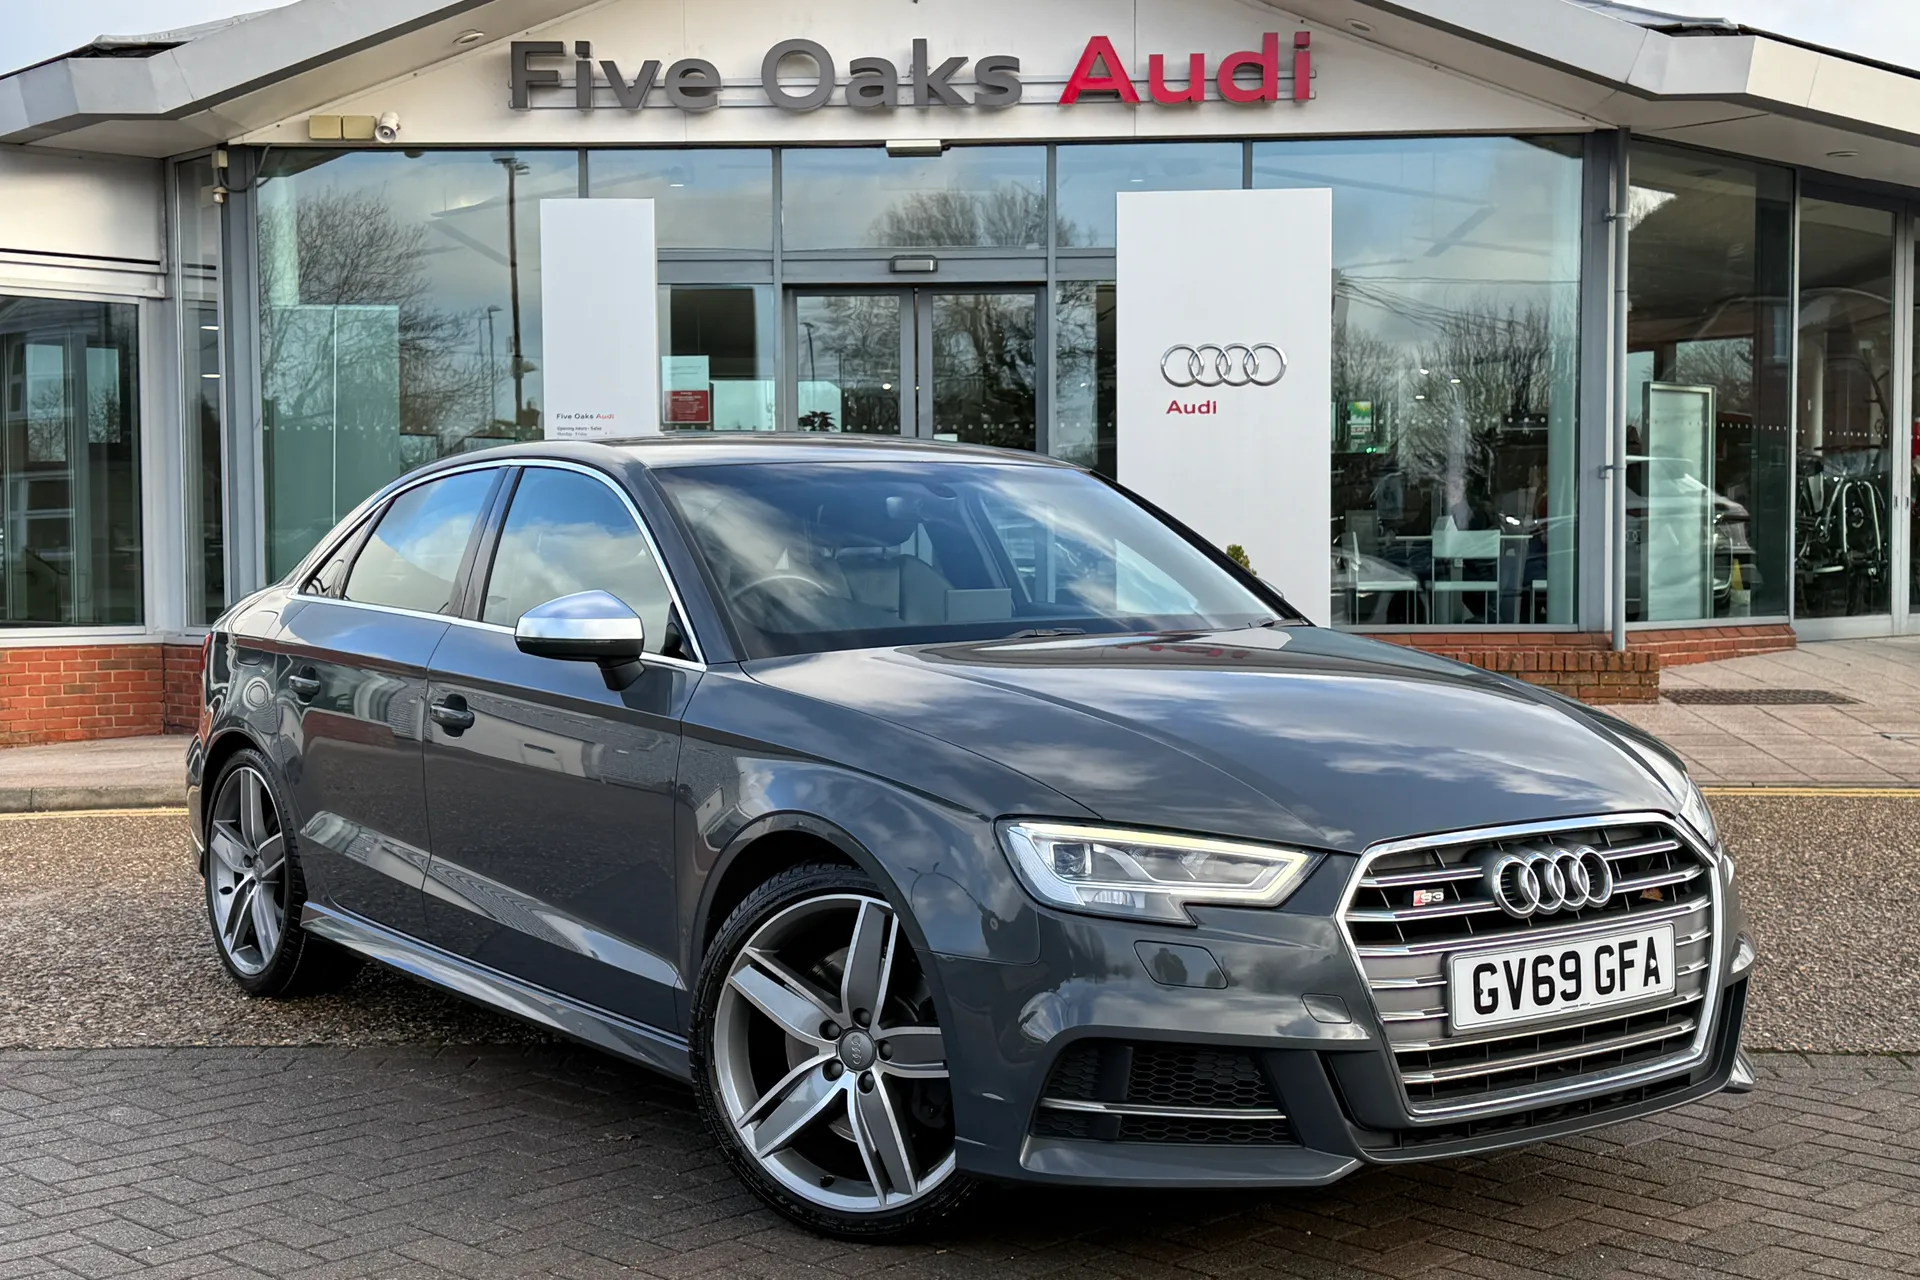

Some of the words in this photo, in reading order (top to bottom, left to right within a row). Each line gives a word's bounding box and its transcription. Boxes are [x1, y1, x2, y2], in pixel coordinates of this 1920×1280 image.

[510, 41, 722, 111] Five
[761, 38, 1022, 110] Oaks
[1058, 32, 1312, 105] Audi
[1166, 399, 1217, 414] Audi
[1420, 891, 1444, 903] S3
[1473, 950, 1582, 1015] GV69
[1594, 936, 1661, 996] GFA
